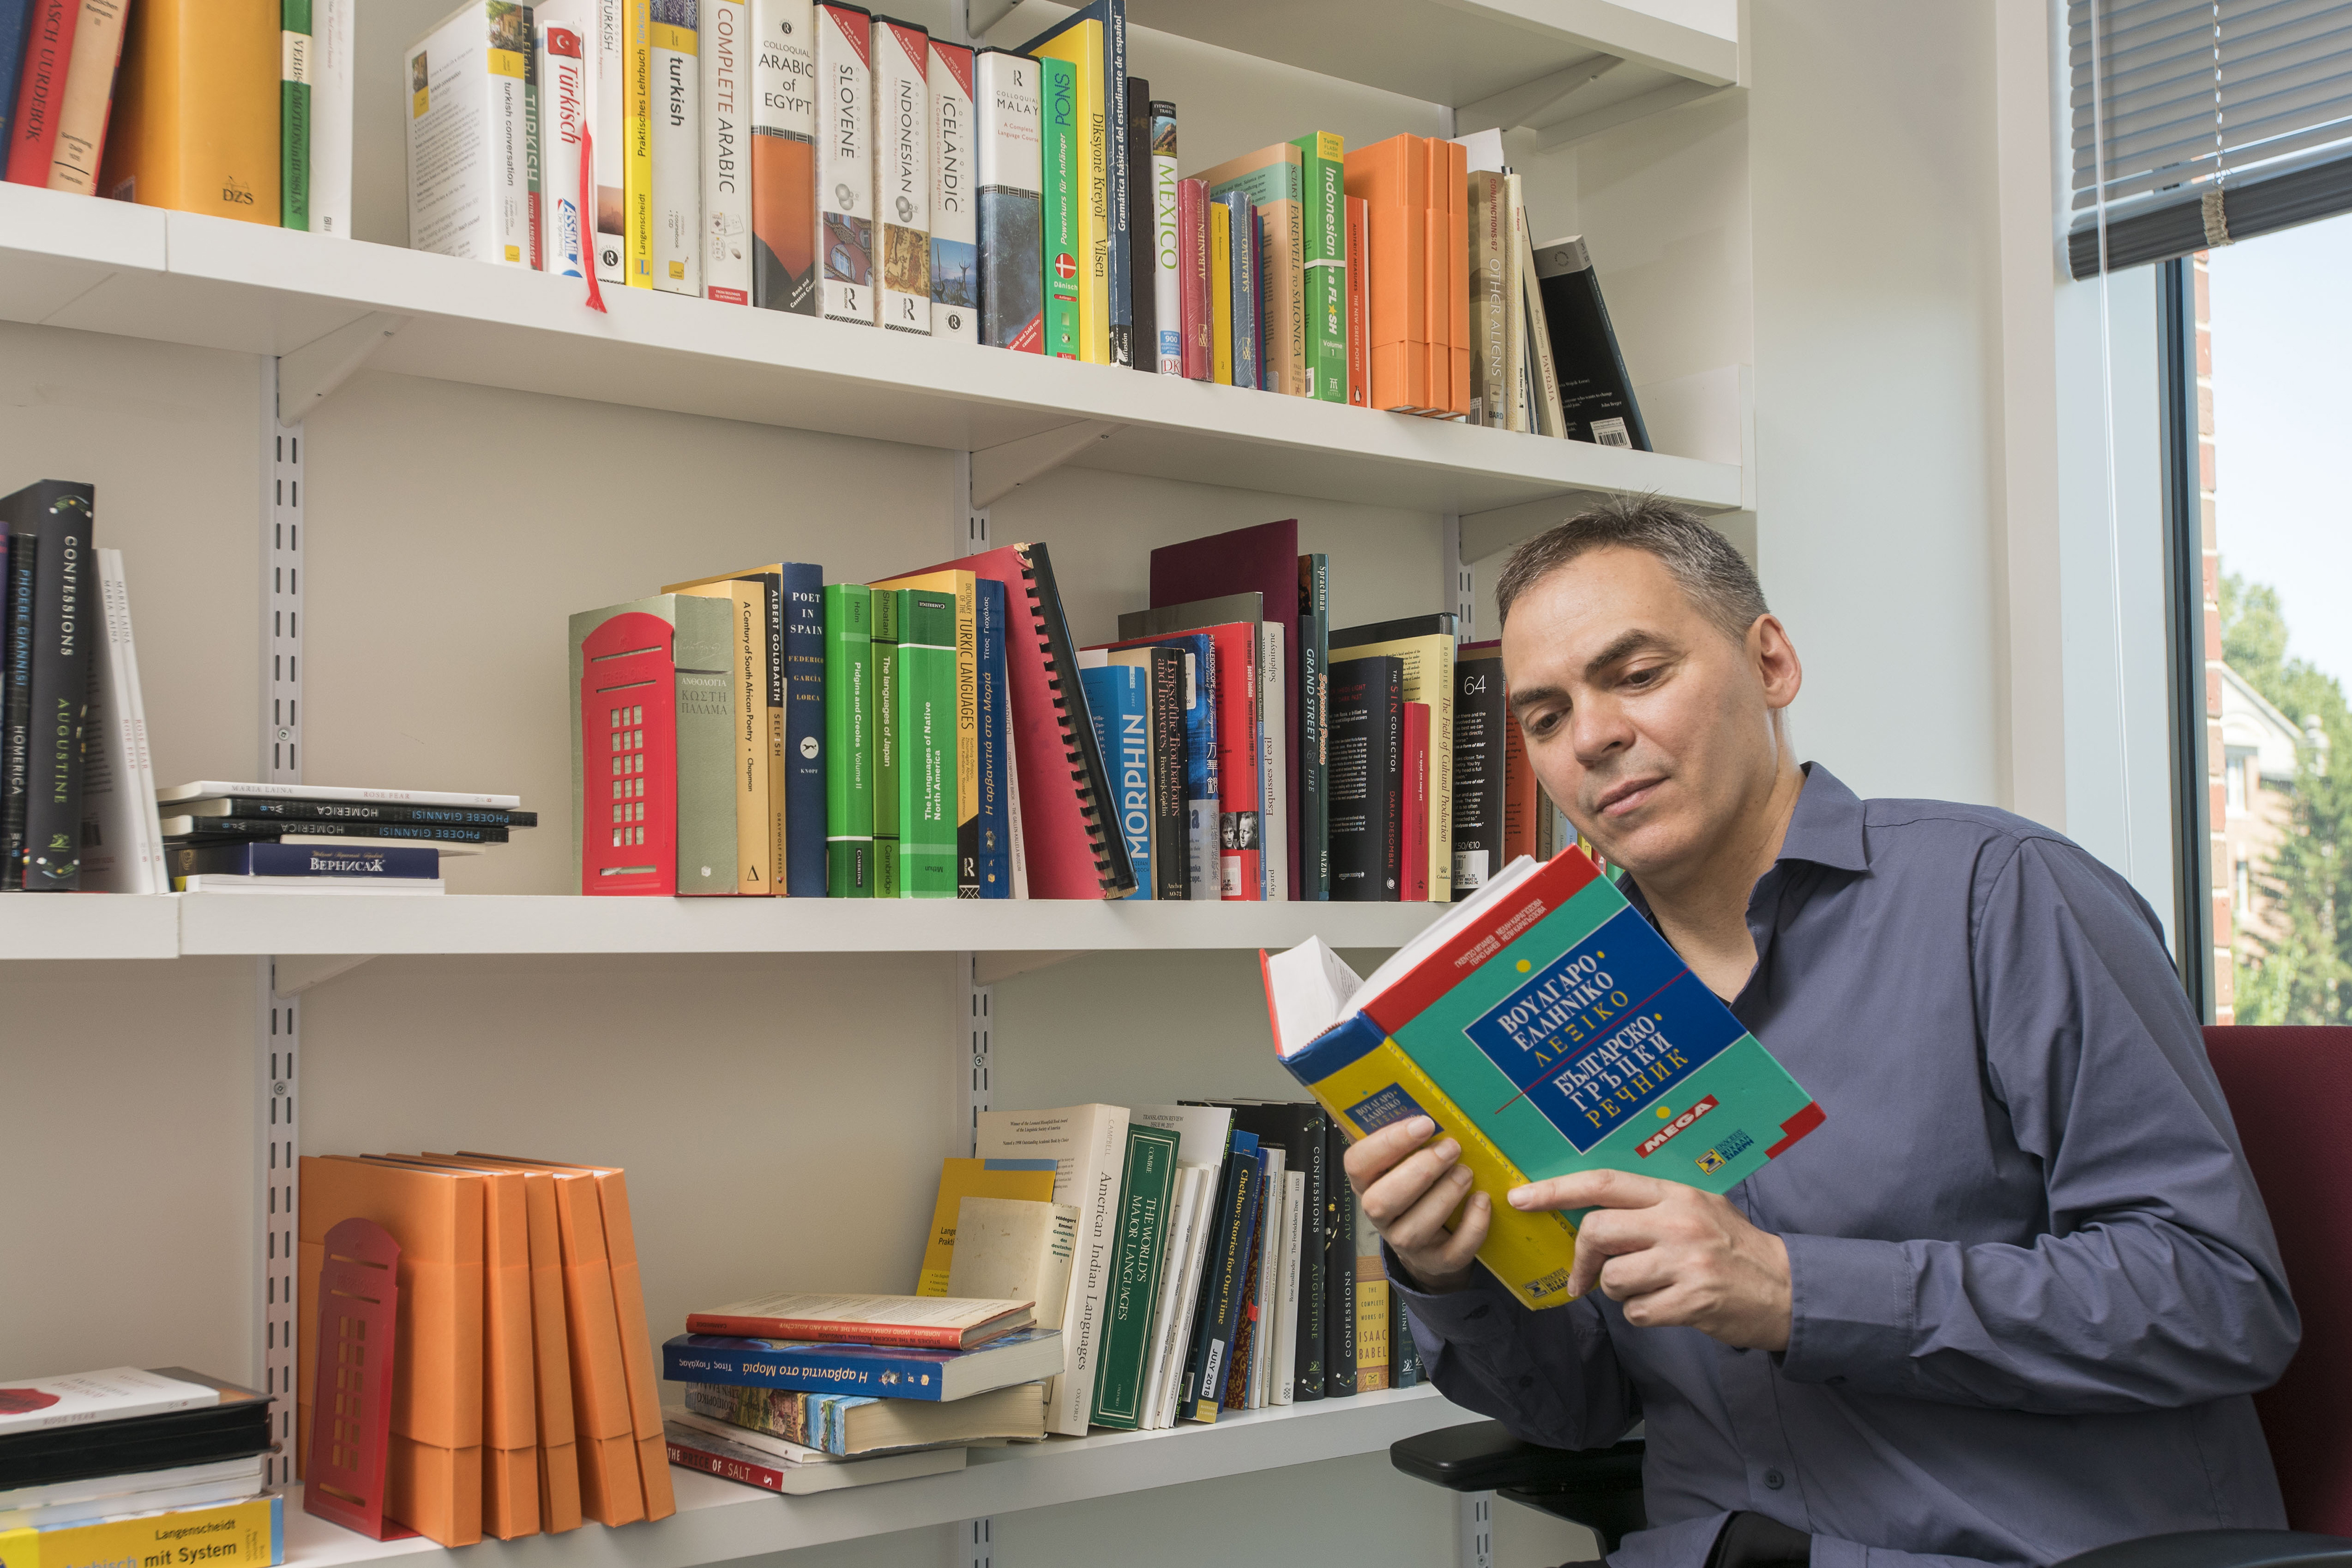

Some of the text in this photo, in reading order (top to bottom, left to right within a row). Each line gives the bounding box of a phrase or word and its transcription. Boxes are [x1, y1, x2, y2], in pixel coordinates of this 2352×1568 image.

[759, 54, 814, 79] ARABIC
[763, 41, 811, 58] COLLOQUIAL
[636, 3, 647, 157] Praktisches Lehrbuch Türkisch
[670, 57, 684, 126] turkish
[783, 80, 796, 92] of
[558, 64, 581, 143] Türkisch
[718, 8, 734, 193] COMPLETE ARABIC
[765, 93, 812, 115] EGYPT
[840, 64, 854, 158] SLOVENE
[997, 91, 1039, 104] COLLOQUIAL
[997, 99, 1039, 115] MALAY
[1055, 73, 1071, 126] PONS
[505, 120, 514, 186] conversation
[900, 80, 912, 192] INDONESIAN
[943, 96, 958, 212] ICELANDIC
[1091, 113, 1105, 217] Diksyonè Kreyòl
[222, 188, 254, 206] DZS
[1326, 167, 1336, 256] Indonesian
[639, 194, 647, 255] Langenscheidt
[1159, 163, 1177, 269] MEXICO
[1291, 204, 1300, 270] FAREWELL
[1095, 239, 1105, 277] Vilsen
[1054, 282, 1078, 290] Dänisch
[1292, 274, 1298, 287] TO
[1292, 291, 1301, 357] SALONICA
[1490, 258, 1502, 376] OTHER ALIENS
[1542, 355, 1555, 402] ΡΑΨΩΔΙΑ
[1488, 410, 1503, 421] BARD
[792, 592, 820, 603] POET
[802, 609, 814, 618] IN
[743, 610, 751, 643] Century
[790, 624, 823, 635] SPAIN
[745, 645, 752, 655] of
[788, 655, 824, 664] FEDERICO
[682, 678, 727, 687] ΑΝΘΟΛΟΓΙΑ
[959, 618, 973, 730] TURKIC LANGUAGES
[1464, 675, 1486, 695] 64
[682, 690, 727, 702] ΚΩΣΤΗ
[682, 703, 727, 715] ΠΑΛΑΜΑ
[983, 673, 992, 712] Μοριά
[1306, 648, 1315, 741] GRAND STREET
[1390, 685, 1398, 713] SIN
[884, 727, 891, 738] of
[924, 735, 931, 746] of
[1443, 719, 1451, 741] Field
[1439, 743, 1450, 756] of
[983, 742, 993, 802] αρβανιτιά
[1122, 713, 1149, 858] MORPHIN
[1442, 758, 1451, 792] Cultural
[317, 805, 378, 817] HOMERICA
[412, 810, 509, 823] PHOEBE GIANNISI
[1441, 794, 1450, 842] Production
[1486, 941, 1501, 956] БАНЕВ
[1512, 972, 1613, 1052] ΕΛΛΗΝΙΚΟ
[1534, 991, 1628, 1067] ΛΕΞΙΚΟ
[1569, 1032, 1673, 1112] ГРЪЦКИ
[1585, 1048, 1688, 1128] РЕЧНИК
[1644, 1103, 1713, 1153] MEGA
[1146, 1146, 1155, 1174] COMRIE
[1137, 1198, 1156, 1282] THE WORLD'S
[1219, 1169, 1248, 1325] Chekhov: Stories for Our Time
[1078, 1172, 1112, 1370] American Indian Languages
[1118, 1195, 1142, 1320] MAJOR LANGUAGES
[1359, 1329, 1386, 1342] ISAAC
[1359, 1346, 1387, 1359] BABEL
[1203, 1348, 1217, 1397] JULY 2018
[668, 1448, 750, 1481] THE PRICE OF SALT
[155, 1519, 236, 1541] Langenscheidt
[144, 1549, 171, 1568] mit
[178, 1542, 236, 1564] System
